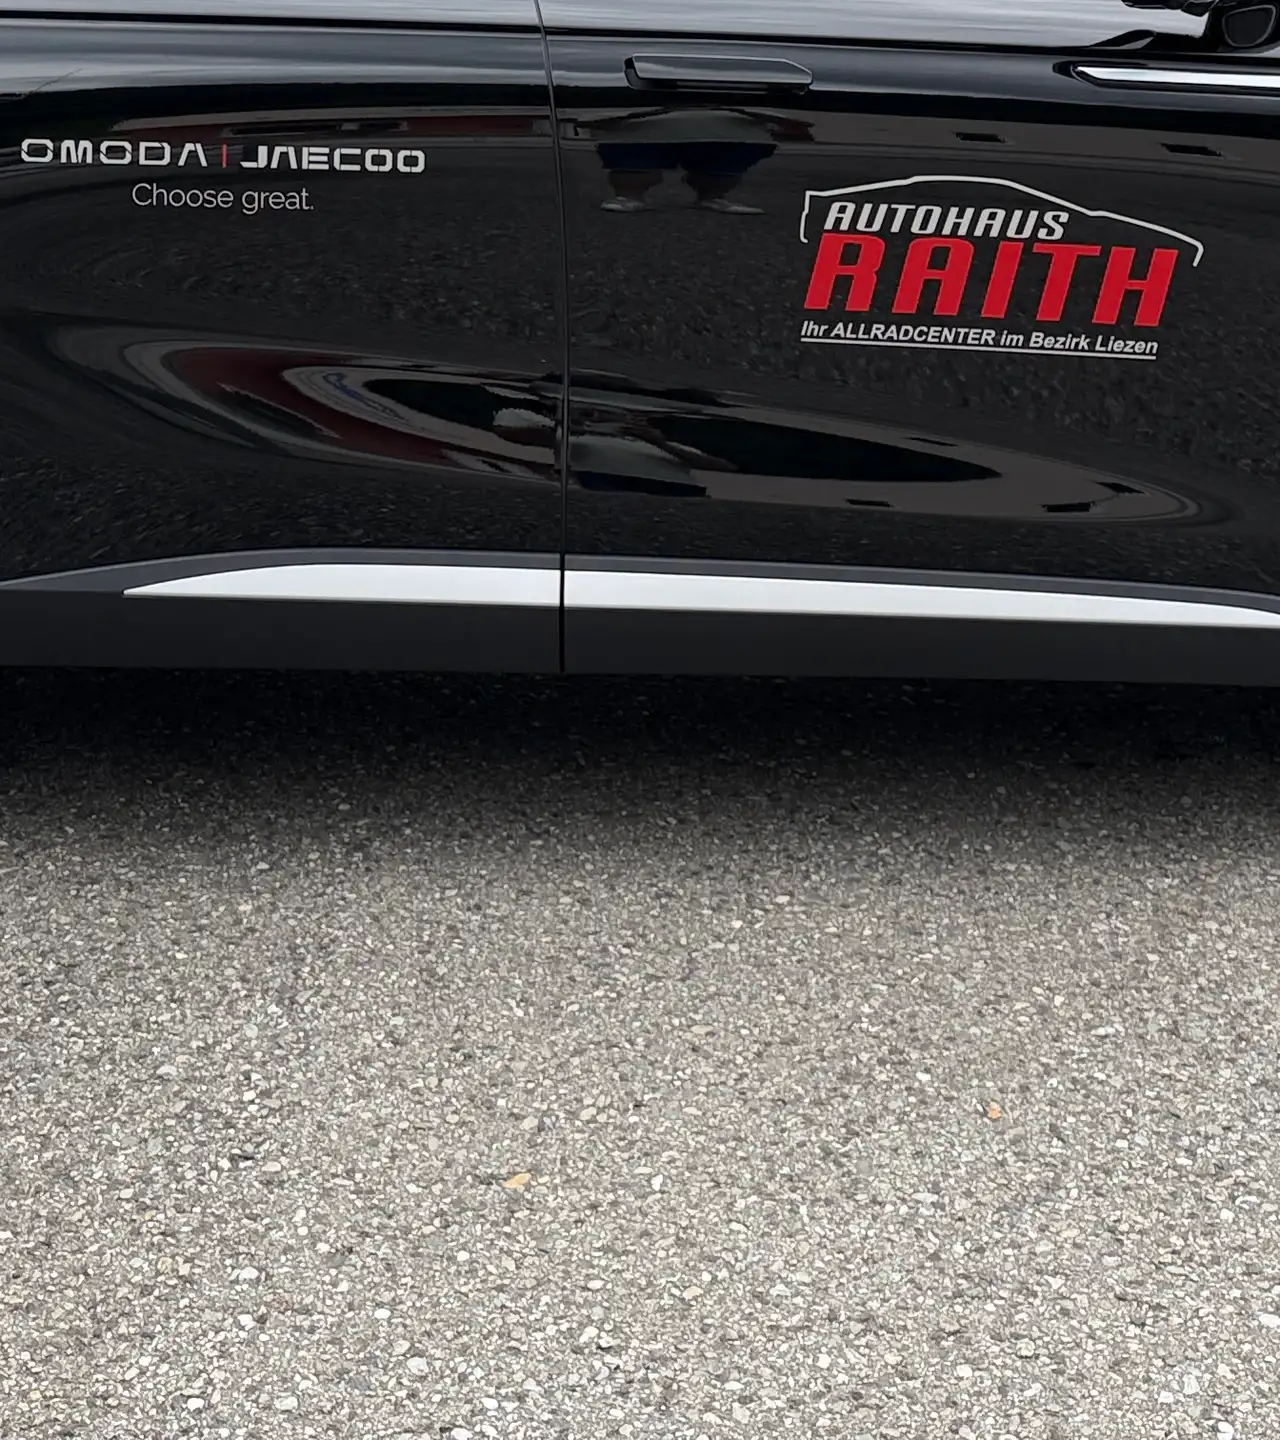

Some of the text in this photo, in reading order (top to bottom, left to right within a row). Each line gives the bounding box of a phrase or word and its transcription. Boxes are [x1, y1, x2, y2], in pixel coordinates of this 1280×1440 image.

[21, 138, 427, 174] OMODA JAECOO
[132, 182, 315, 215] Choose great.
[823, 201, 1071, 241] AUTOHAUS
[803, 232, 1179, 327] RAITH
[801, 321, 1159, 355] Ihr ALLRADCENTER im Bezirk Liezen
